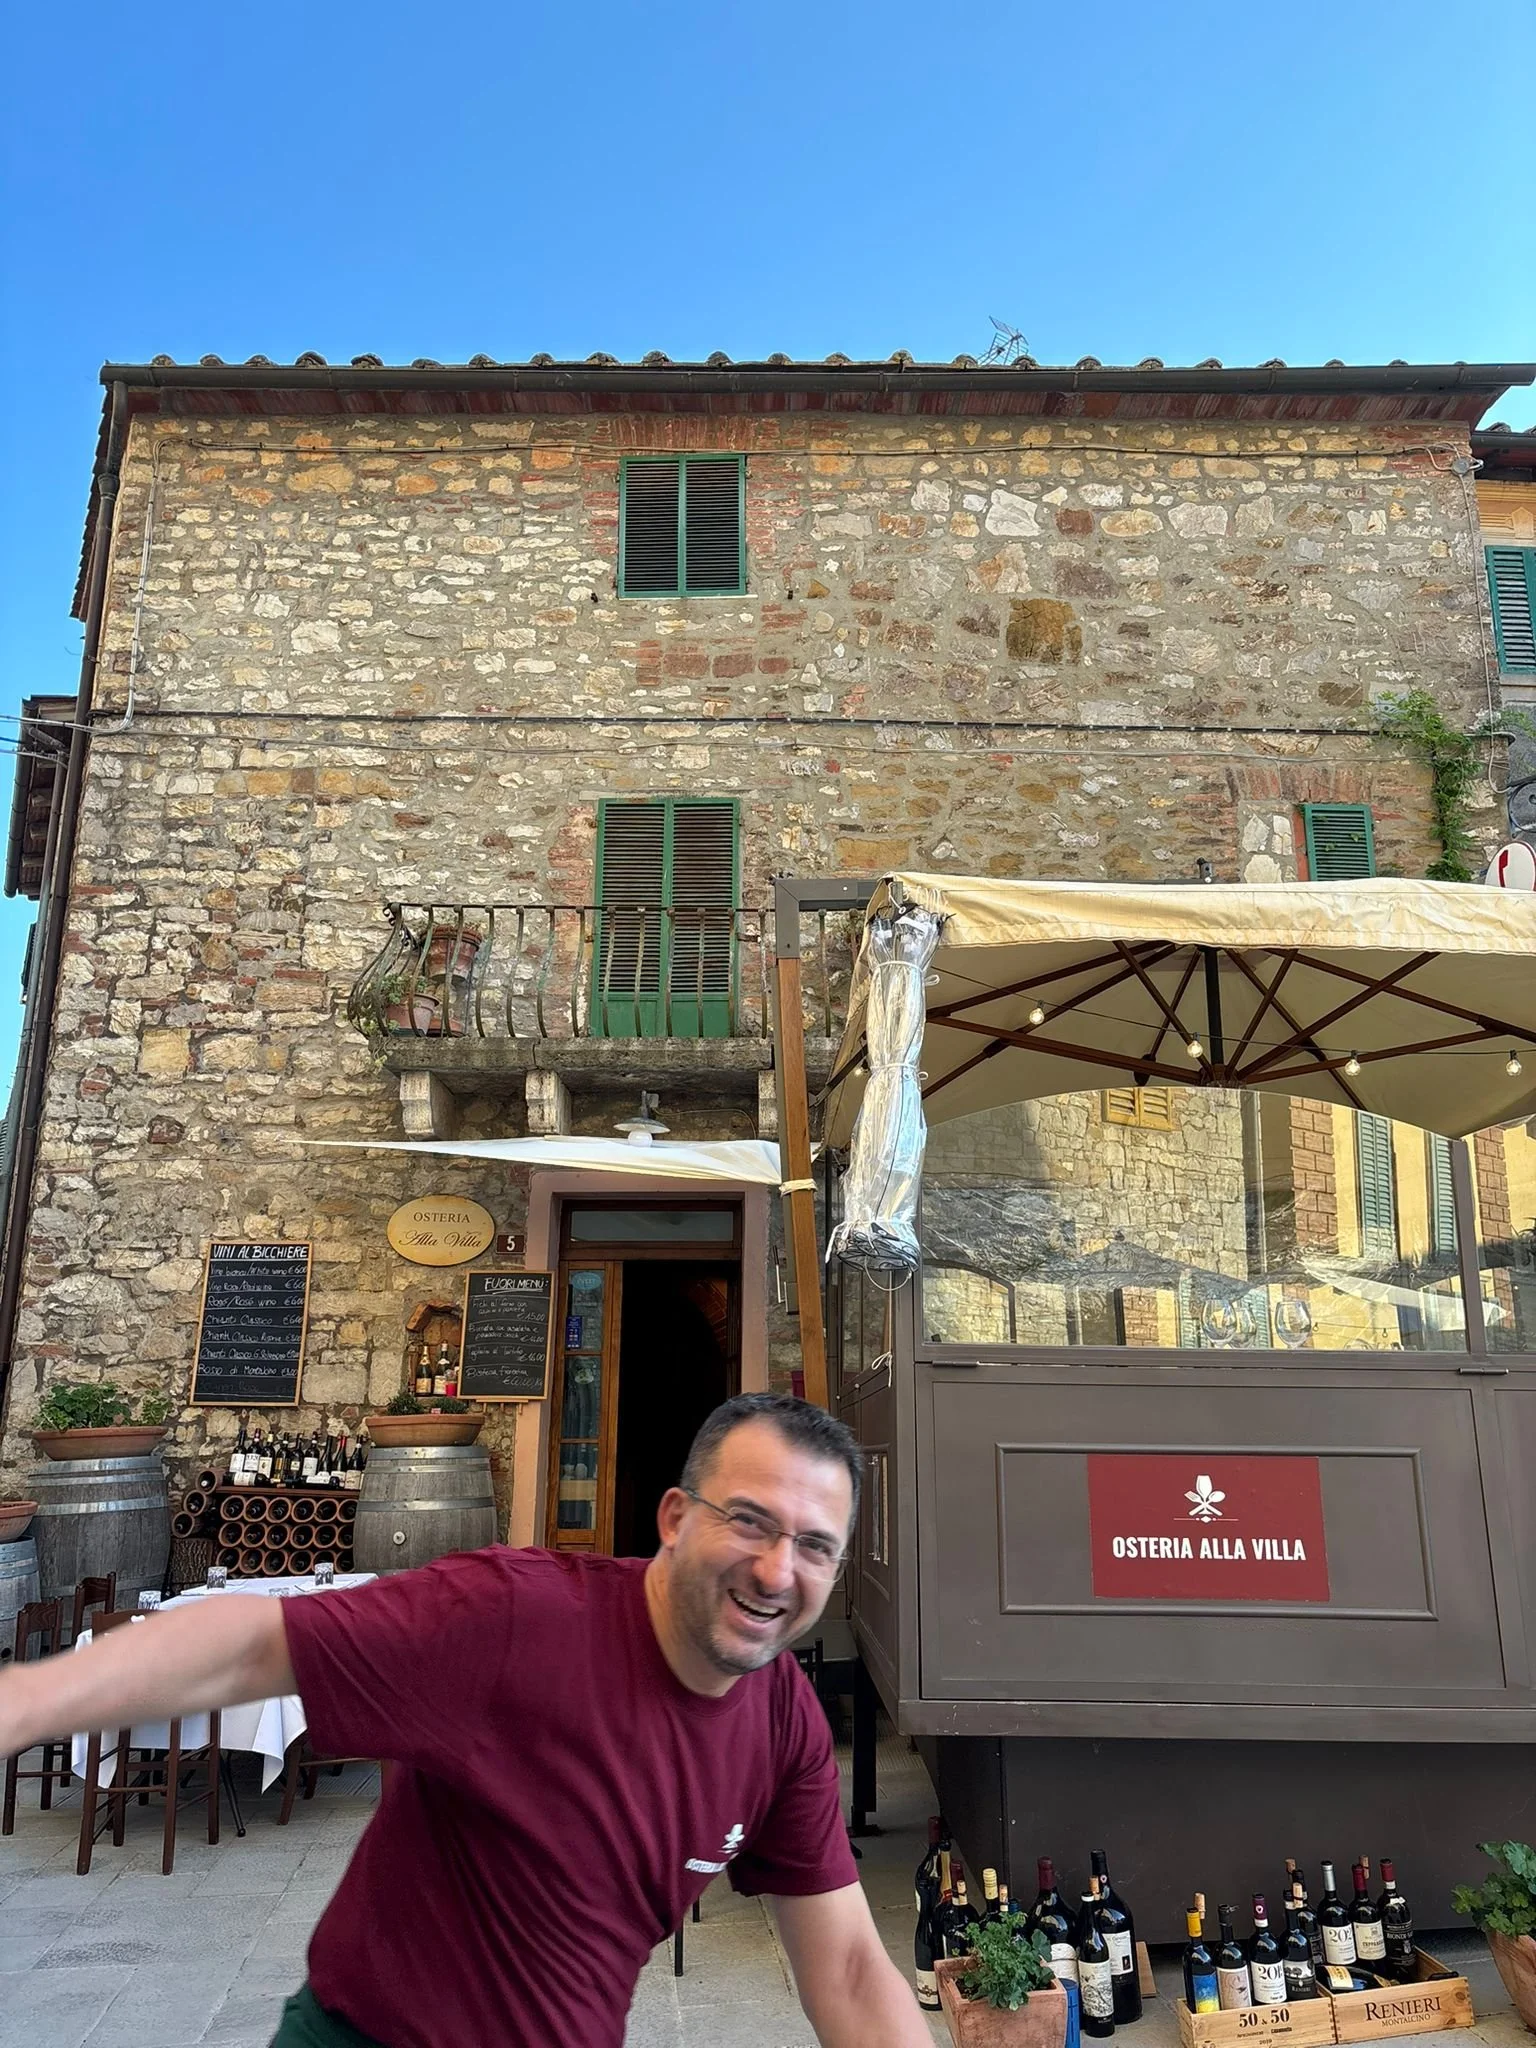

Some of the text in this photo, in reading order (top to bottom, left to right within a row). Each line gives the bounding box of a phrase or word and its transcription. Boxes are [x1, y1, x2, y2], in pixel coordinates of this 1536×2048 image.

[413, 1212, 470, 1223] OSTERIA
[398, 1230, 482, 1248] Alla Villa
[506, 1236, 516, 1252] 5
[213, 1244, 309, 1259] VINI AL BICCHIERE
[485, 1277, 516, 1289] FUORI
[230, 1365, 238, 1375] di
[1112, 1536, 1306, 1561] OSTERIA ALLA VILLA
[1364, 1996, 1442, 2021] RENIERI
[1239, 2012, 1258, 2028] 50
[1270, 2008, 1290, 2024] 50
[1382, 2014, 1431, 2027] MONTALCINO
